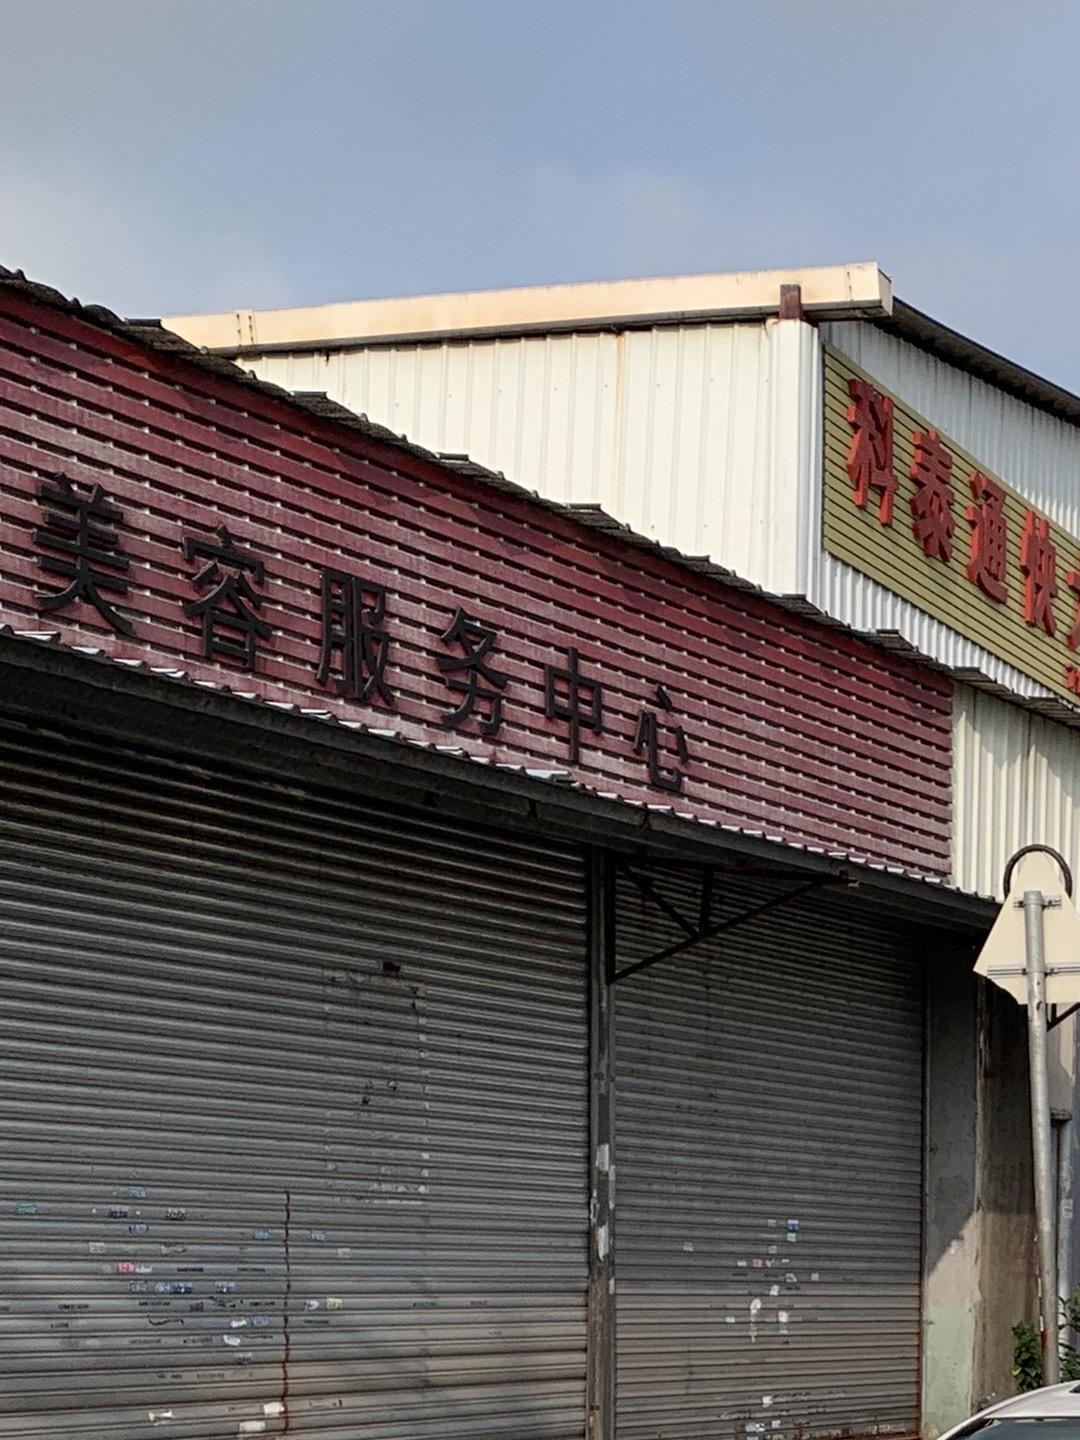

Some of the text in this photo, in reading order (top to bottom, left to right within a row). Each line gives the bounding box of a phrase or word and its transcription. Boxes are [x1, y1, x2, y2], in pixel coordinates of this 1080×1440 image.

[34, 472, 690, 793] 美容服务中心
